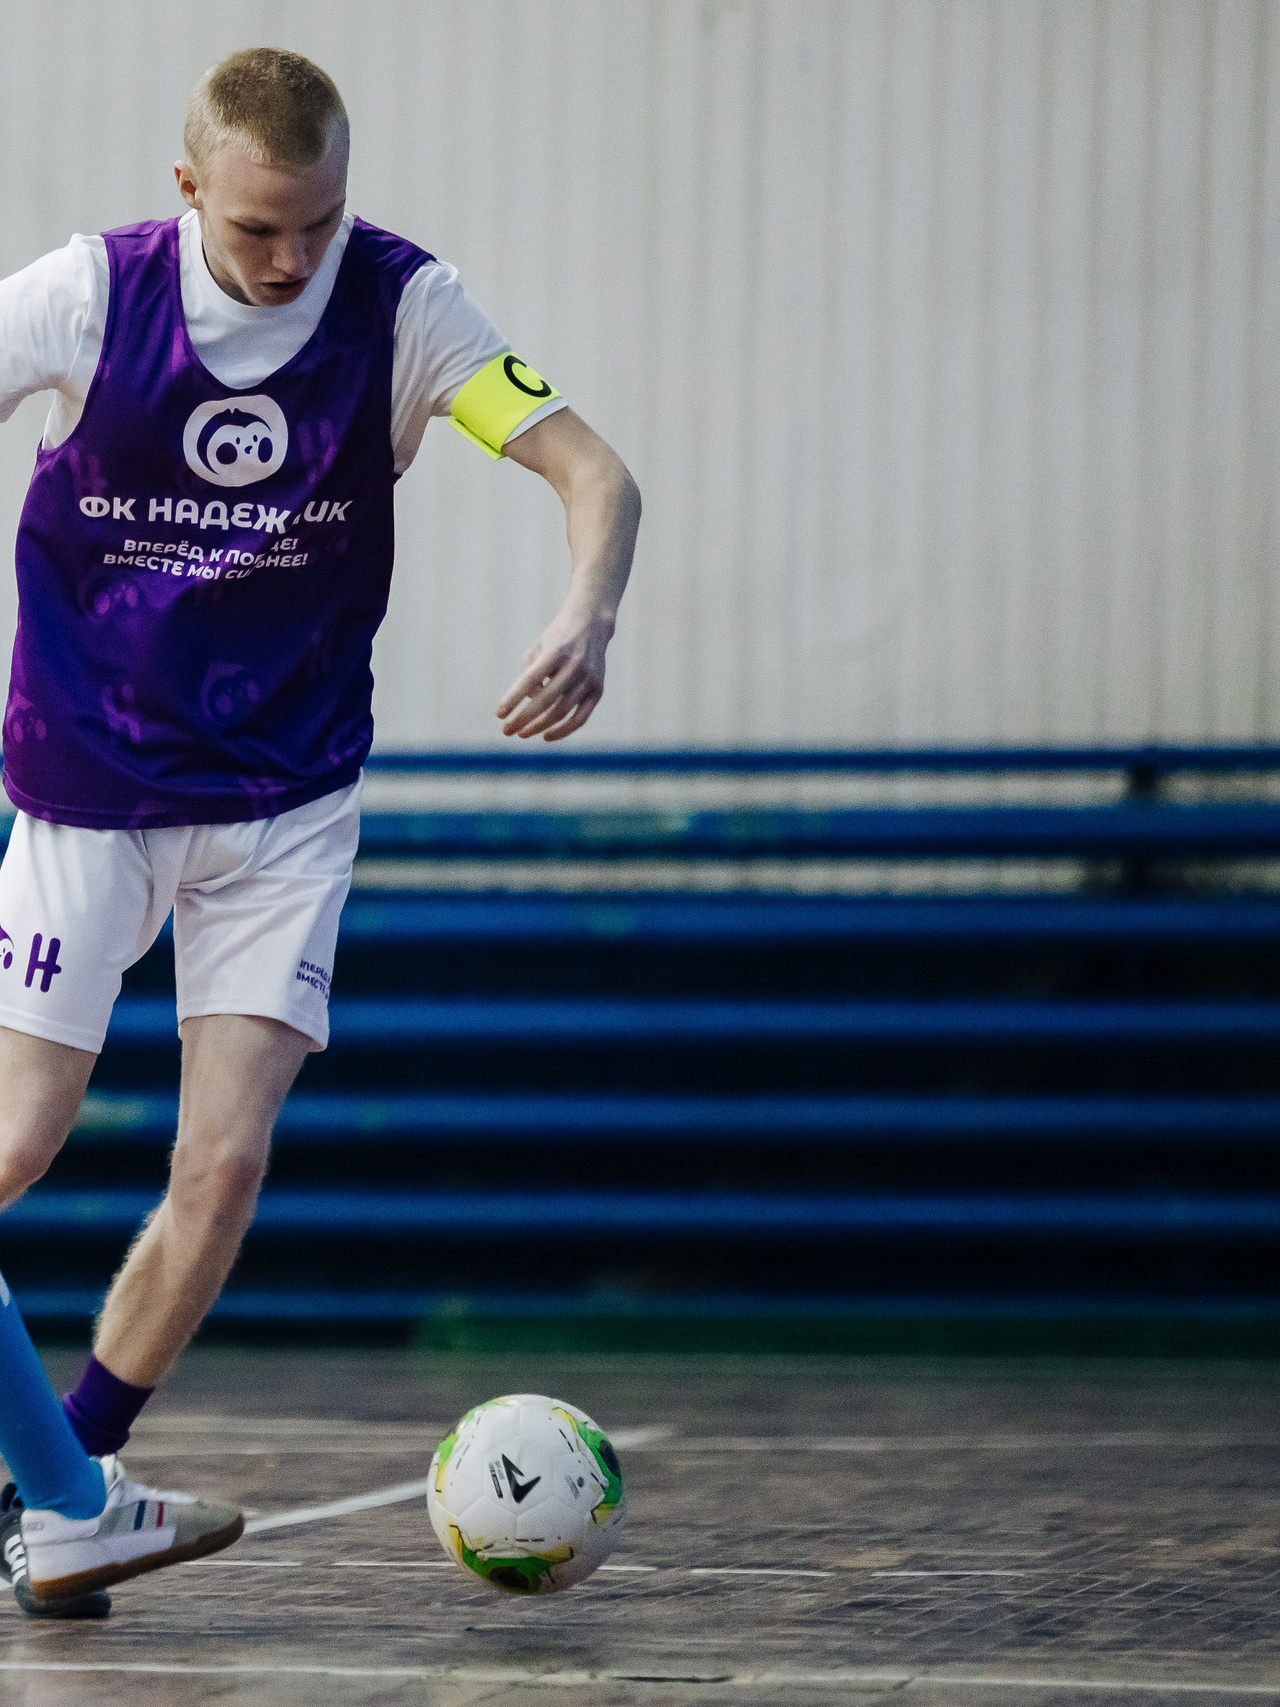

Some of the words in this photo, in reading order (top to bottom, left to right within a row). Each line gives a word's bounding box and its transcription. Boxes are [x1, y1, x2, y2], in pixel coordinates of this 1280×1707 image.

[78, 496, 137, 521] ФК
[147, 497, 353, 535] НАДЕЖИК
[123, 539, 205, 563] ВПЕРЁД
[209, 548, 224, 562] К
[102, 553, 185, 576] ВМЕСТЕ
[187, 563, 222, 580] МЫ
[224, 553, 309, 580] СИЬНЕЕ!
